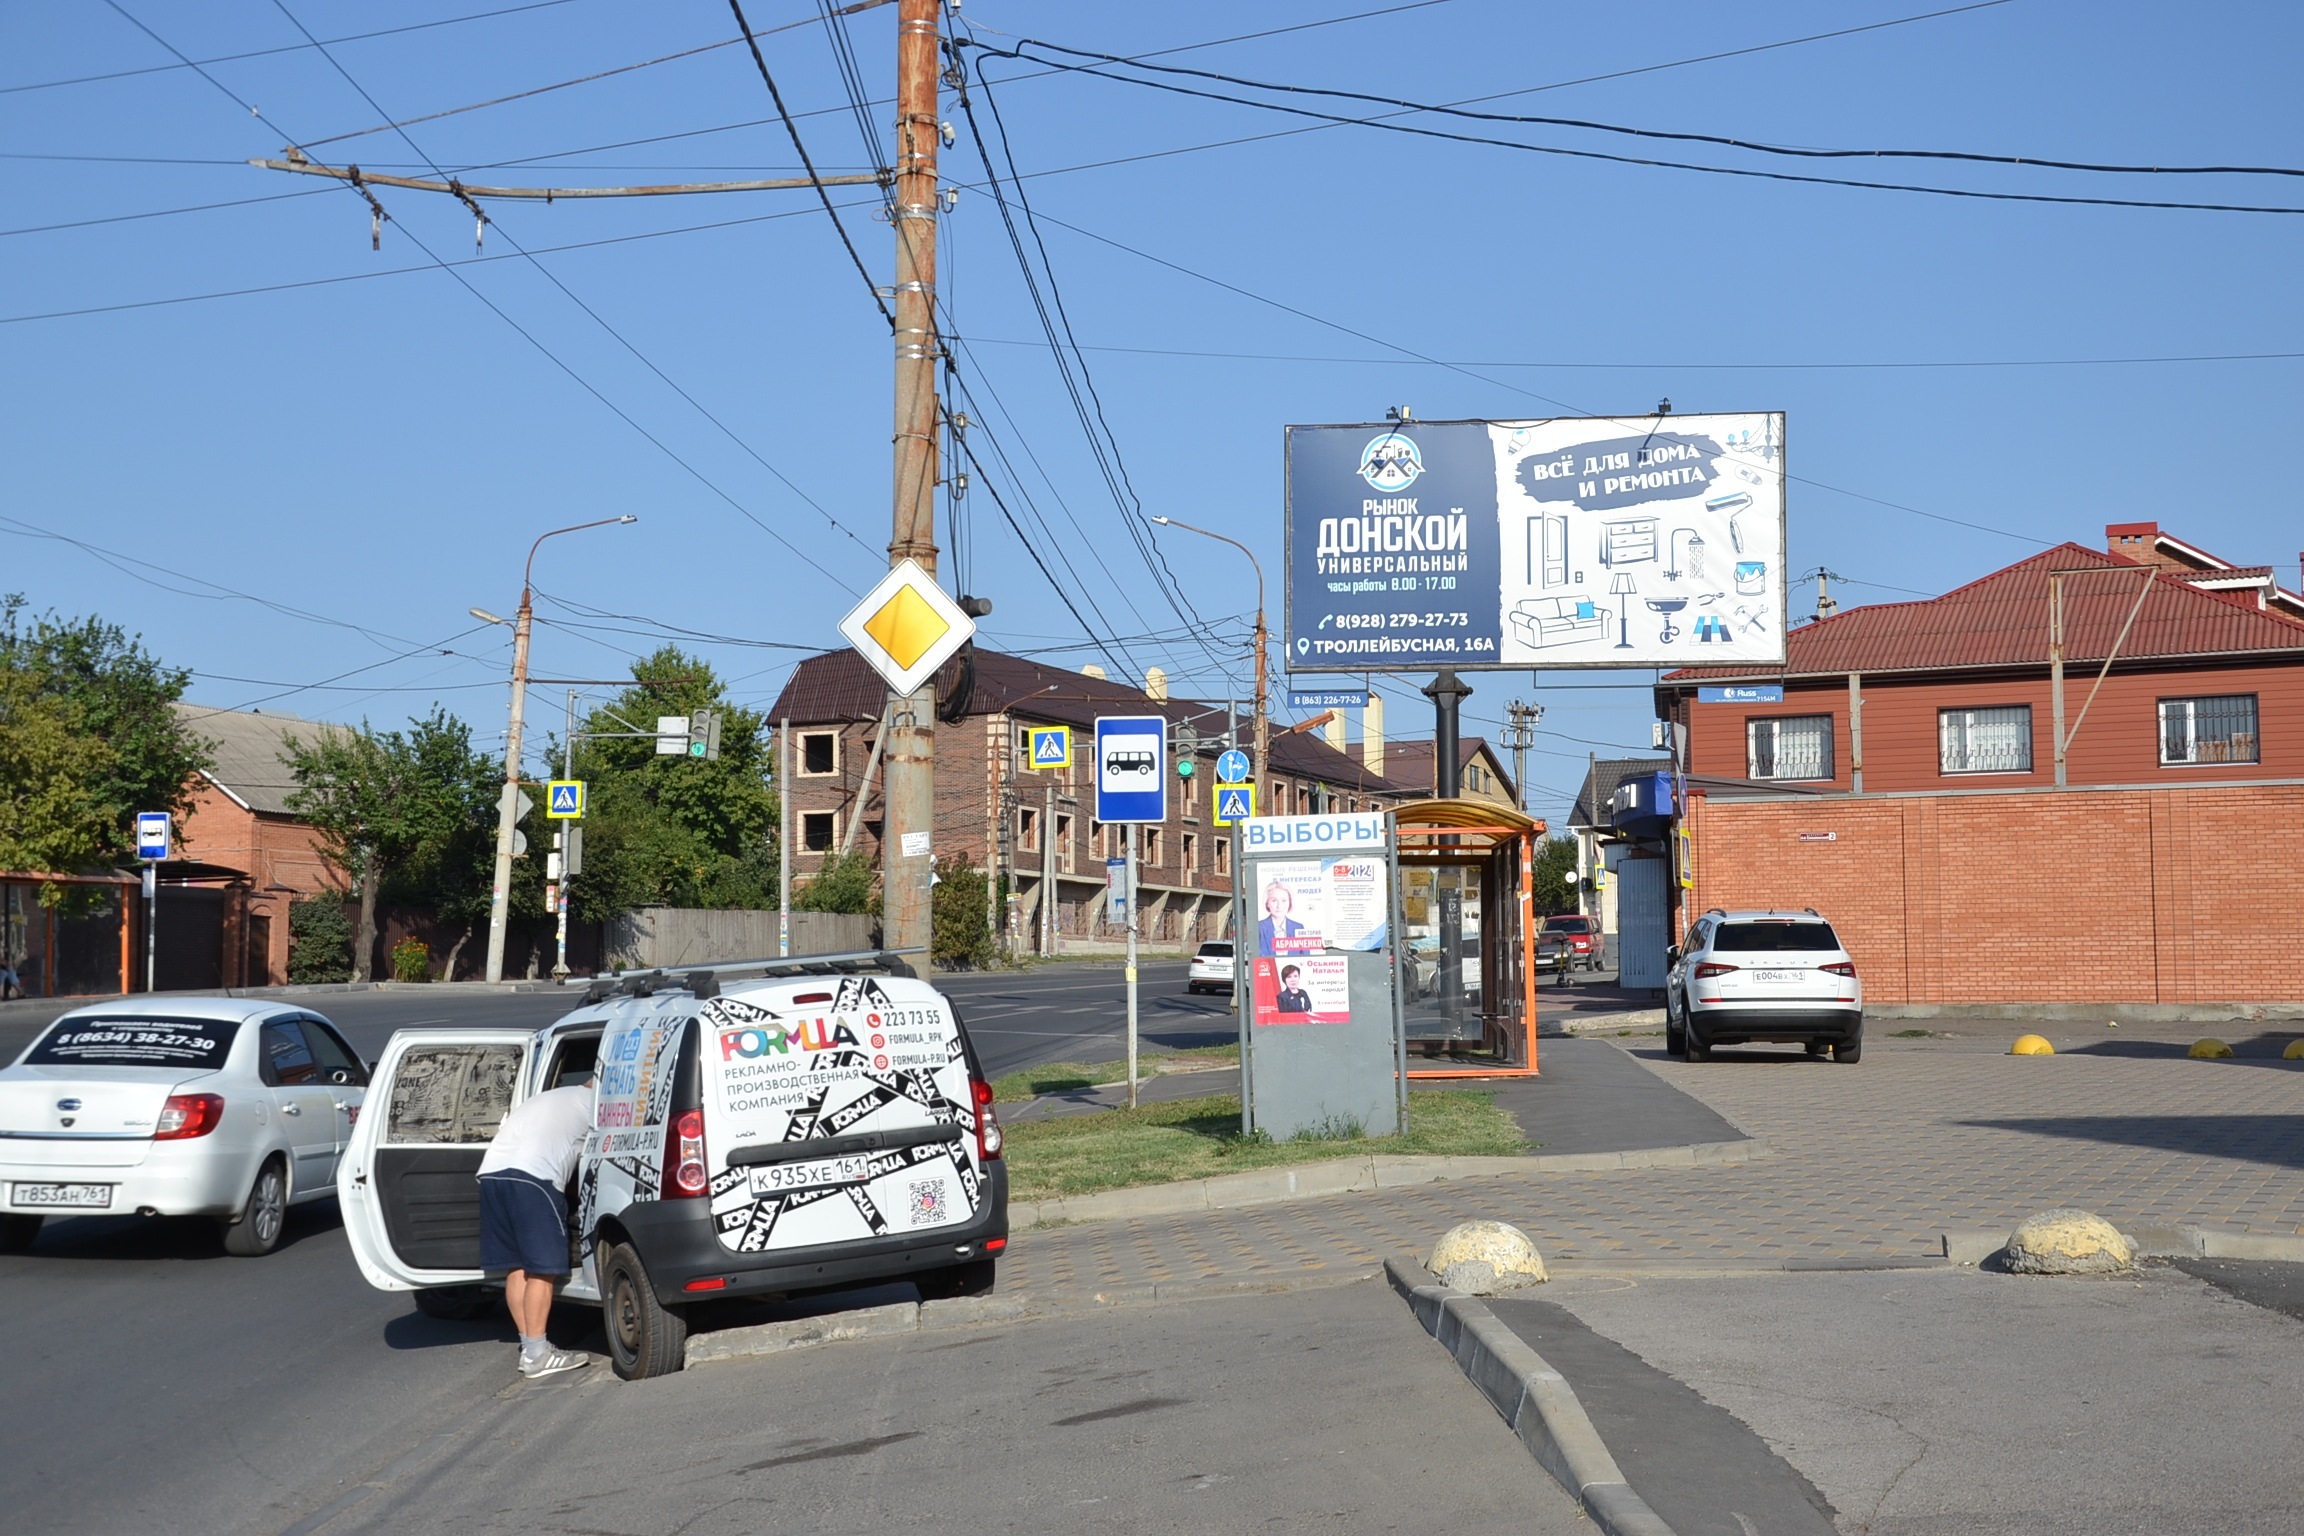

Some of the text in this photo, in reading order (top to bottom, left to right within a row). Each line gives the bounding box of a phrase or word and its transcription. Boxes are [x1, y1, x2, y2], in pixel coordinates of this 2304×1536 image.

[1533, 443, 1701, 481] ВСЁ ДЛЯ ДОМА
[1578, 466, 1707, 498] И РЕМОНТА
[1363, 498, 1419, 516] РЫНОК
[1317, 507, 1467, 557] ДОНСКОЙ
[1317, 552, 1468, 574] УНИВЕРСАЛЬНЫЙ
[1328, 581, 1351, 592] часы
[1352, 577, 1387, 595] работы
[1391, 577, 1417, 590] 8.00
[1425, 576, 1456, 590] 17.00
[1336, 613, 1468, 629] 8(928) 279-27-73
[1313, 636, 1494, 654] ТРОЛЛЕЙБУСНАЯ, 16А
[1294, 695, 1361, 705] 8 (863) 226-77-26
[1737, 689, 1757, 697] Russ
[1249, 819, 1378, 845] ВЫБОРЫ
[1275, 938, 1321, 949] АБРАМЧЕНКО
[884, 1010, 940, 1026] 223 73 55
[57, 1033, 72, 1044] 8
[72, 1031, 132, 1044] (8634)
[133, 1032, 215, 1051] 38-27-30
[719, 1015, 860, 1062] FORMULA
[888, 1032, 944, 1044] FORMULA_RPK
[892, 1053, 946, 1066] FORMULA-P.RU
[724, 1060, 801, 1079] РЕКЛАМНО-
[601, 1064, 636, 1095] ПЕЧАТЬ
[727, 1069, 859, 1096] ПРОИЗВОДСТВЕННАЯ
[729, 1092, 804, 1113] КОМПАНИЯ
[597, 1101, 634, 1127] БАННЕРЫ
[758, 1158, 863, 1190] К935ХЕ 161
[82, 1186, 106, 1199] 761
